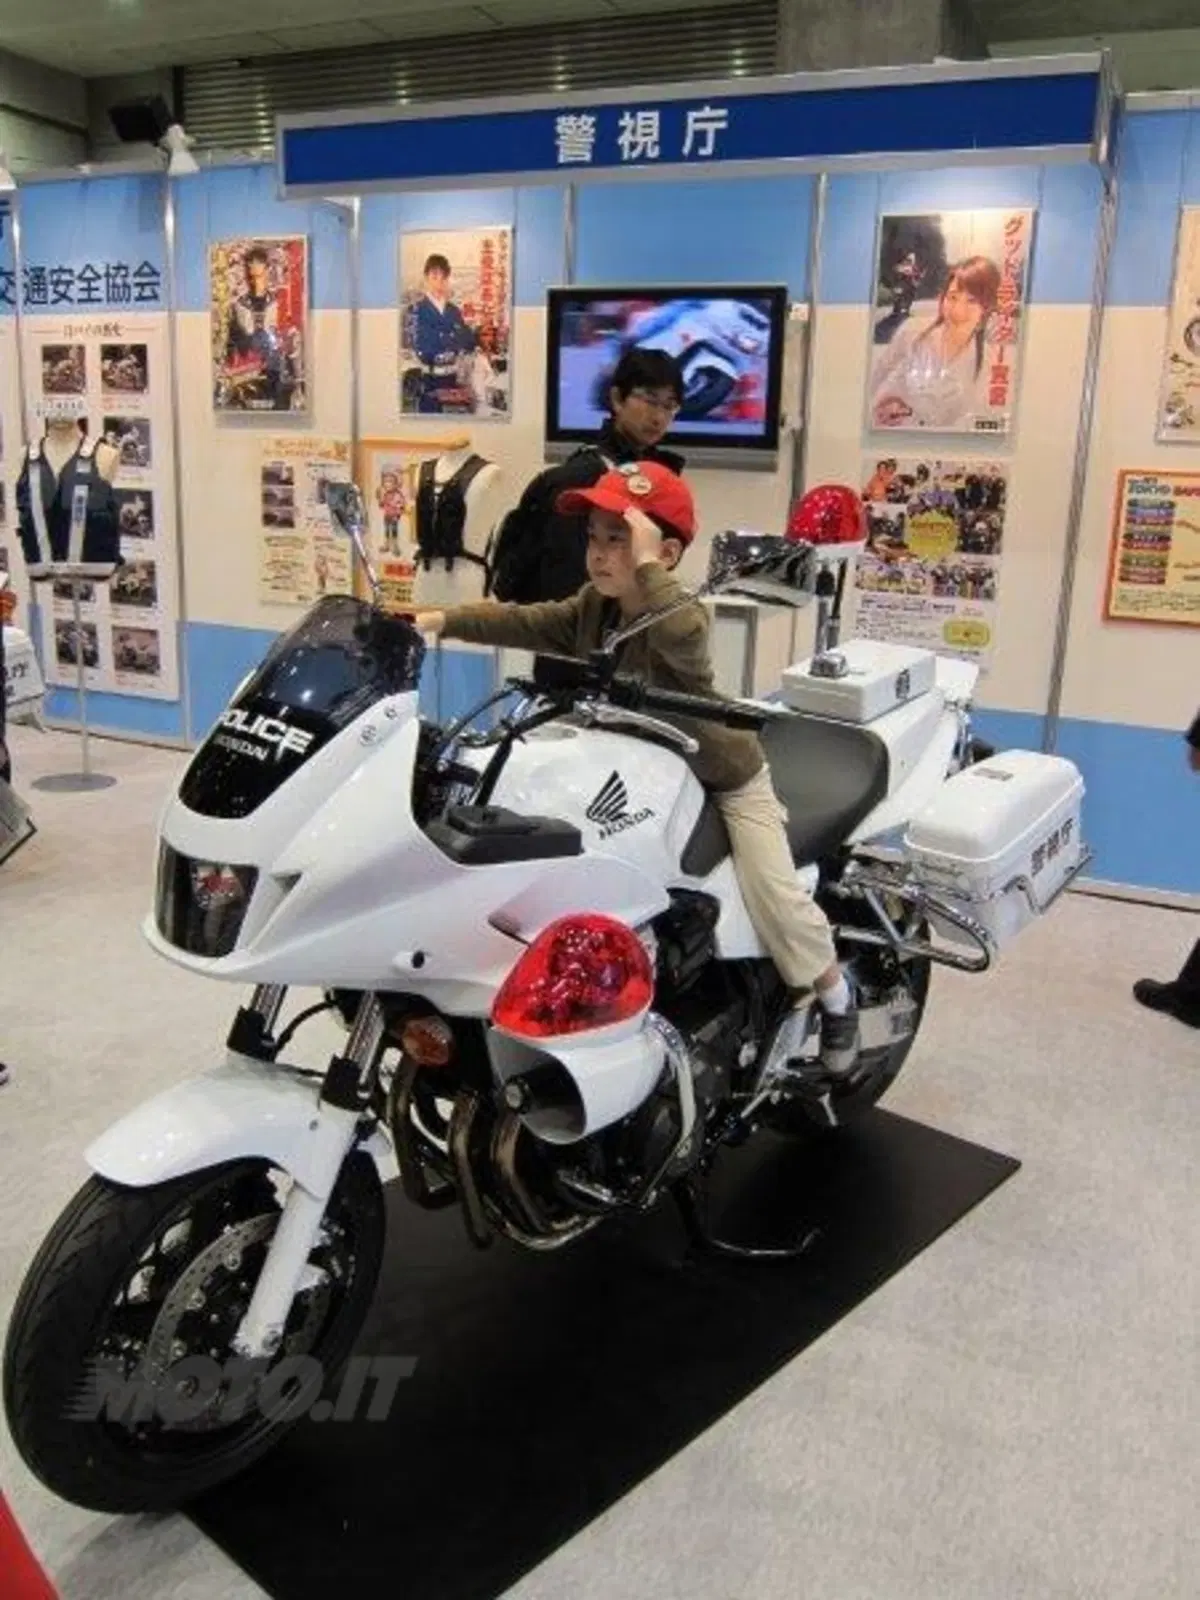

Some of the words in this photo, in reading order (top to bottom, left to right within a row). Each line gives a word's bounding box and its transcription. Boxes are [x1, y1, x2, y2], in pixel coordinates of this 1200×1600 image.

[554, 105, 729, 164] 警視庁
[0, 261, 161, 305] 交通安全協会
[599, 808, 655, 840] HONDA
